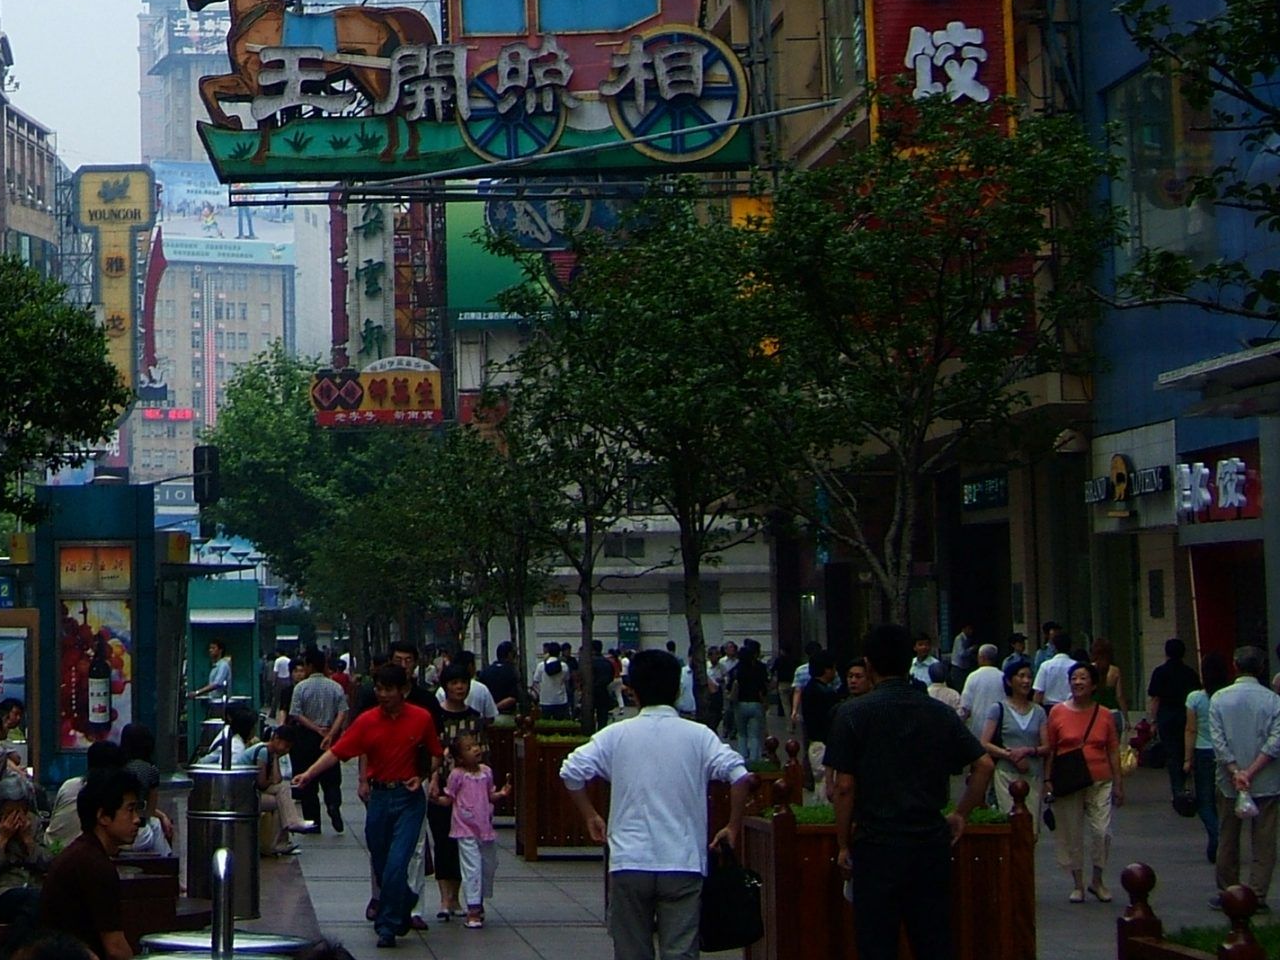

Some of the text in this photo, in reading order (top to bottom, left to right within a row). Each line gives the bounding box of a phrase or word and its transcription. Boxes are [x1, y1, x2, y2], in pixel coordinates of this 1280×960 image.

[88, 208, 141, 221] YOUNGOR
[154, 489, 194, 501] GIO
[0, 583, 9, 598] 2
